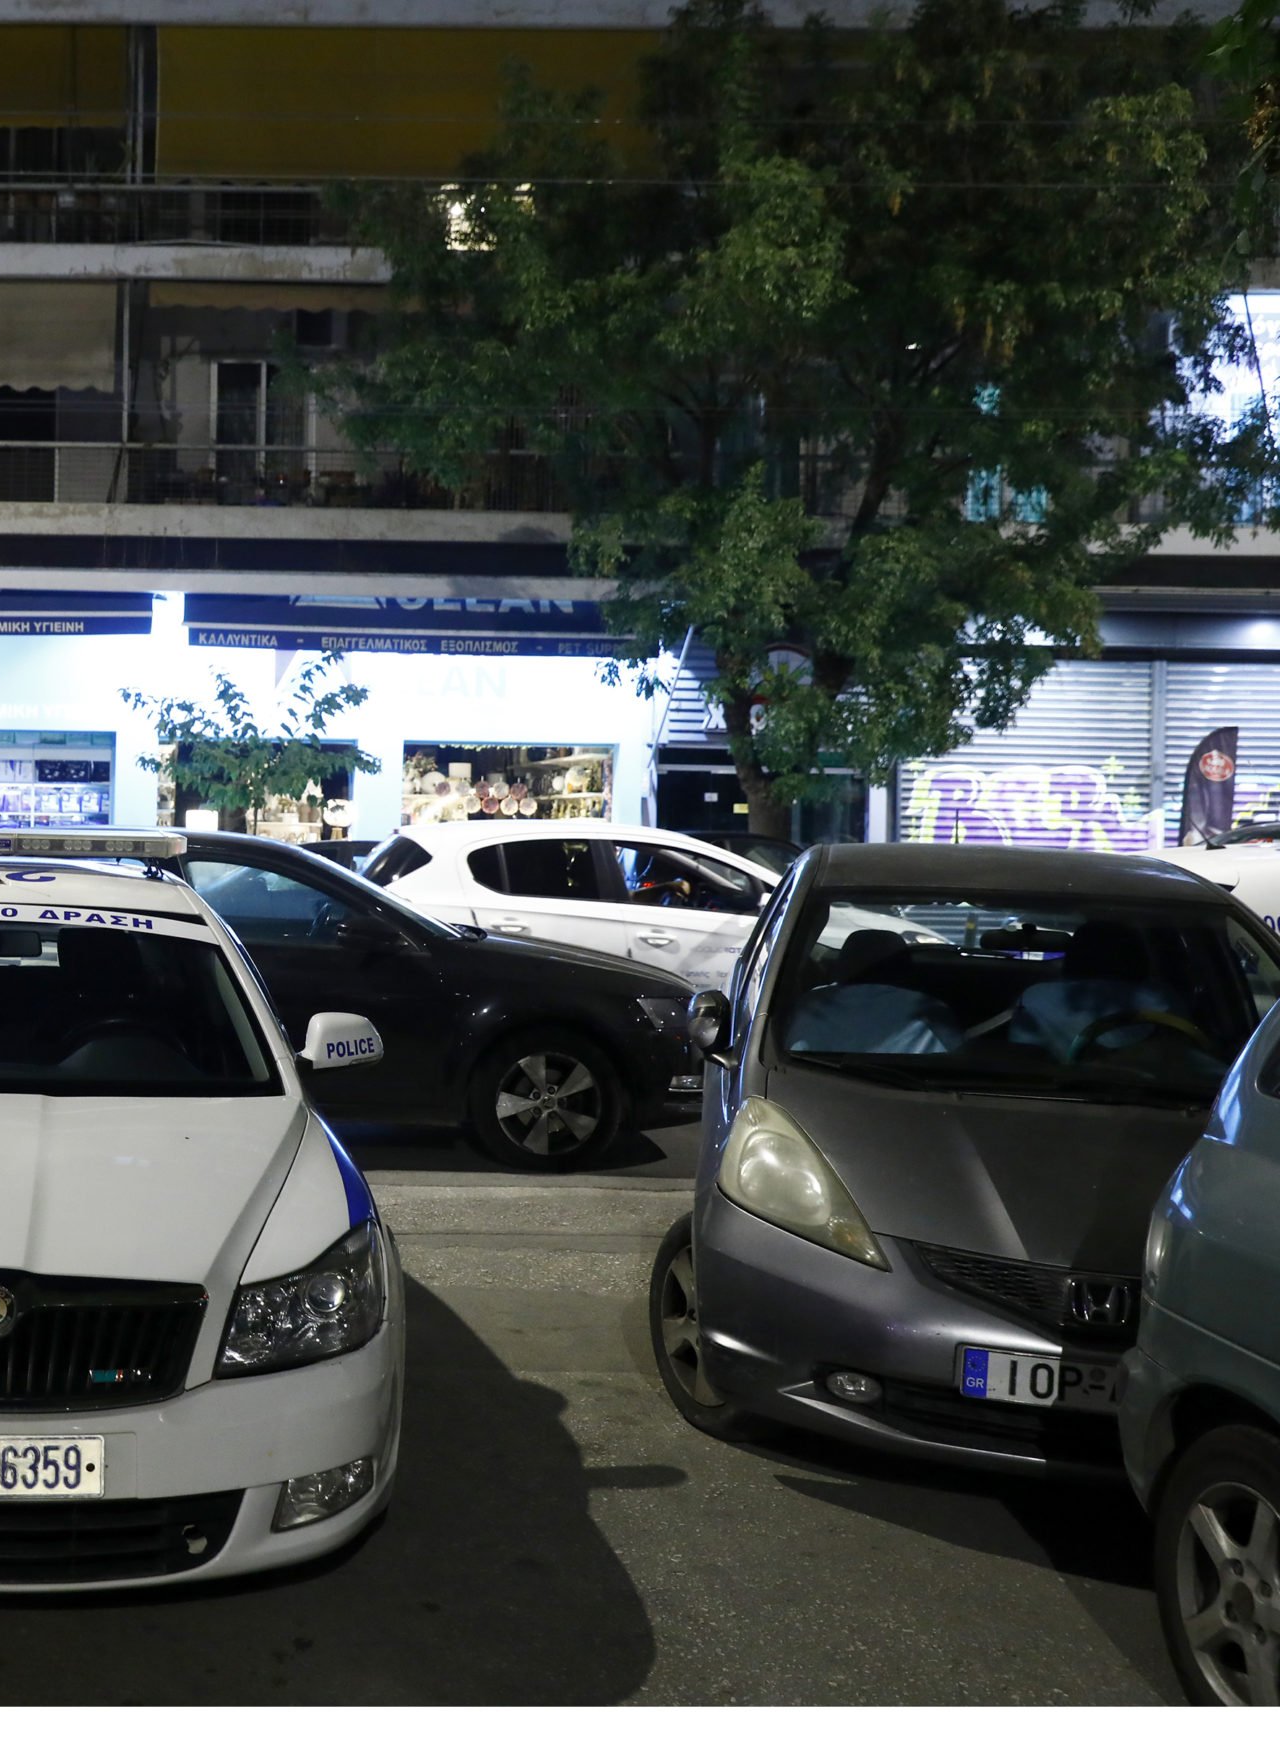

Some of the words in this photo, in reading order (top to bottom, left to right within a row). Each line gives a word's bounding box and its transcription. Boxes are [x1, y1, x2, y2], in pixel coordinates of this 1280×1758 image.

[33, 621, 84, 633] ΥΓΙΕΙΝΗ
[198, 633, 278, 646] ΚΑΛΛΥΝΤΙΚΑ
[321, 637, 428, 652] ΕΠΑΓΓΕΛΜΑΤΙΚΟΣ
[440, 640, 519, 653] ΕΞΟΠΛΙΣΜΟΣ
[38, 908, 154, 930] ΔΡΑΣΗ
[326, 1037, 375, 1059] POLICE
[966, 1376, 985, 1389] GR
